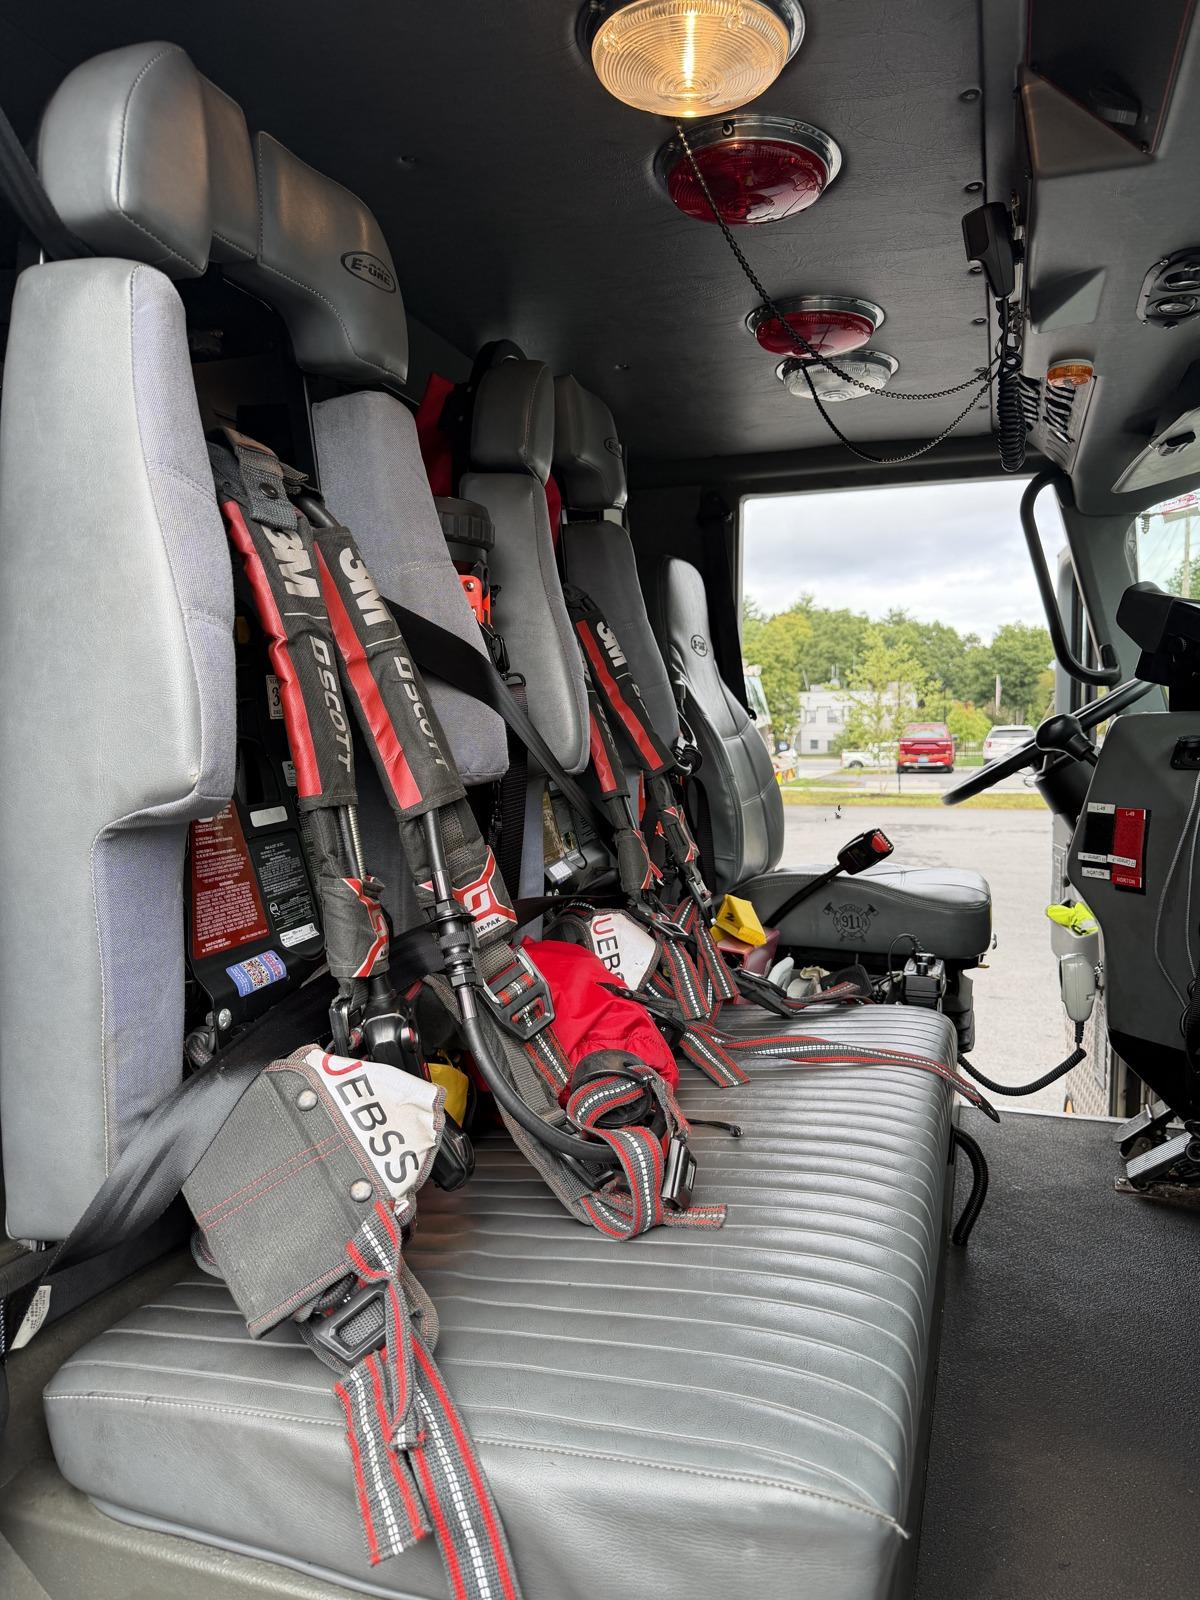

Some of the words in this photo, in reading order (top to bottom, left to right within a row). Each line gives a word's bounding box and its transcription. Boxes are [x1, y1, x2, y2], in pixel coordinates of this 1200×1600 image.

[351, 257, 392, 287] E-ONE
[261, 524, 321, 598] 3M
[339, 546, 392, 627] 3M
[596, 621, 628, 668] 3M
[317, 666, 352, 773] SCOTT
[592, 916, 625, 982] UEB
[841, 914, 861, 929] 911
[322, 1053, 420, 1184] UEBSS
